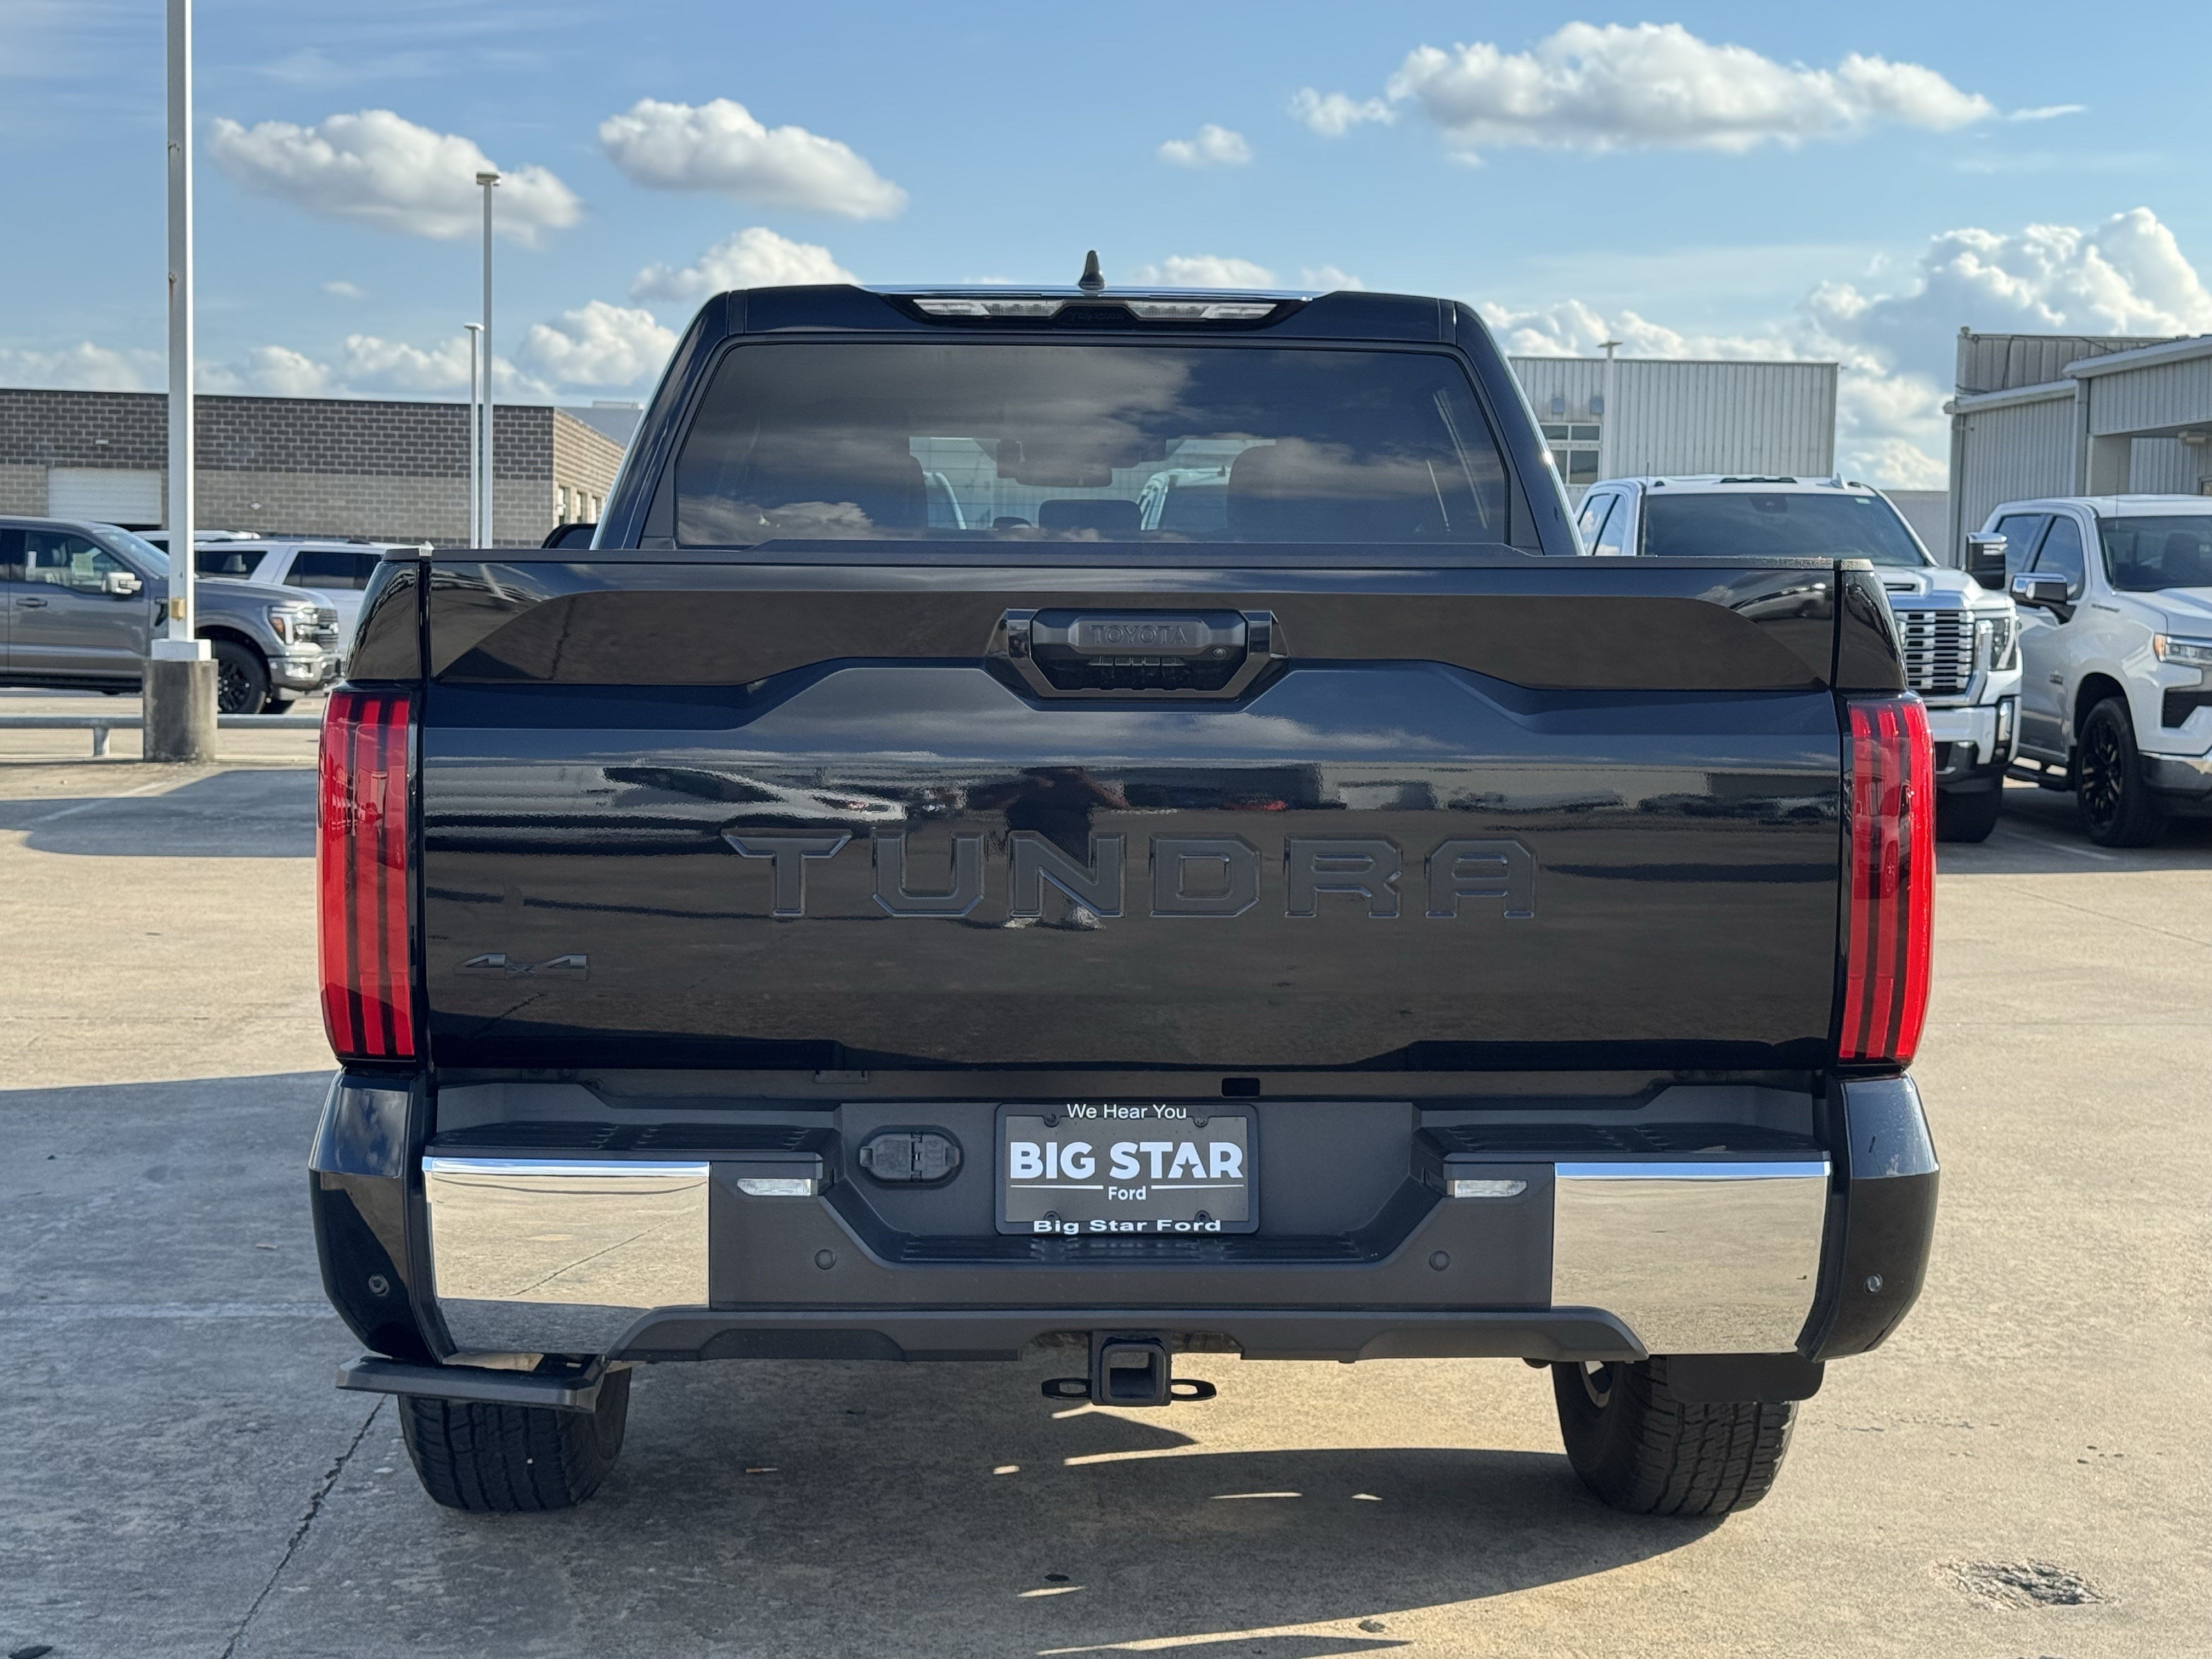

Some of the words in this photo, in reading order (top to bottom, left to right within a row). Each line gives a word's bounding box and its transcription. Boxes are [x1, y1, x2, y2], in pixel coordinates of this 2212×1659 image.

[1090, 625, 1188, 644] TOYOTA
[721, 831, 1539, 920] TUNDRA
[1067, 1104, 1097, 1119] We
[1104, 1104, 1148, 1119] Hear
[1153, 1104, 1187, 1119] You
[1010, 1142, 1096, 1180] BIG
[1109, 1142, 1243, 1180] STAR
[1108, 1186, 1147, 1200] Ford
[1033, 1220, 1080, 1235] Big
[1090, 1220, 1147, 1232] Star
[1156, 1220, 1221, 1232] Ford
